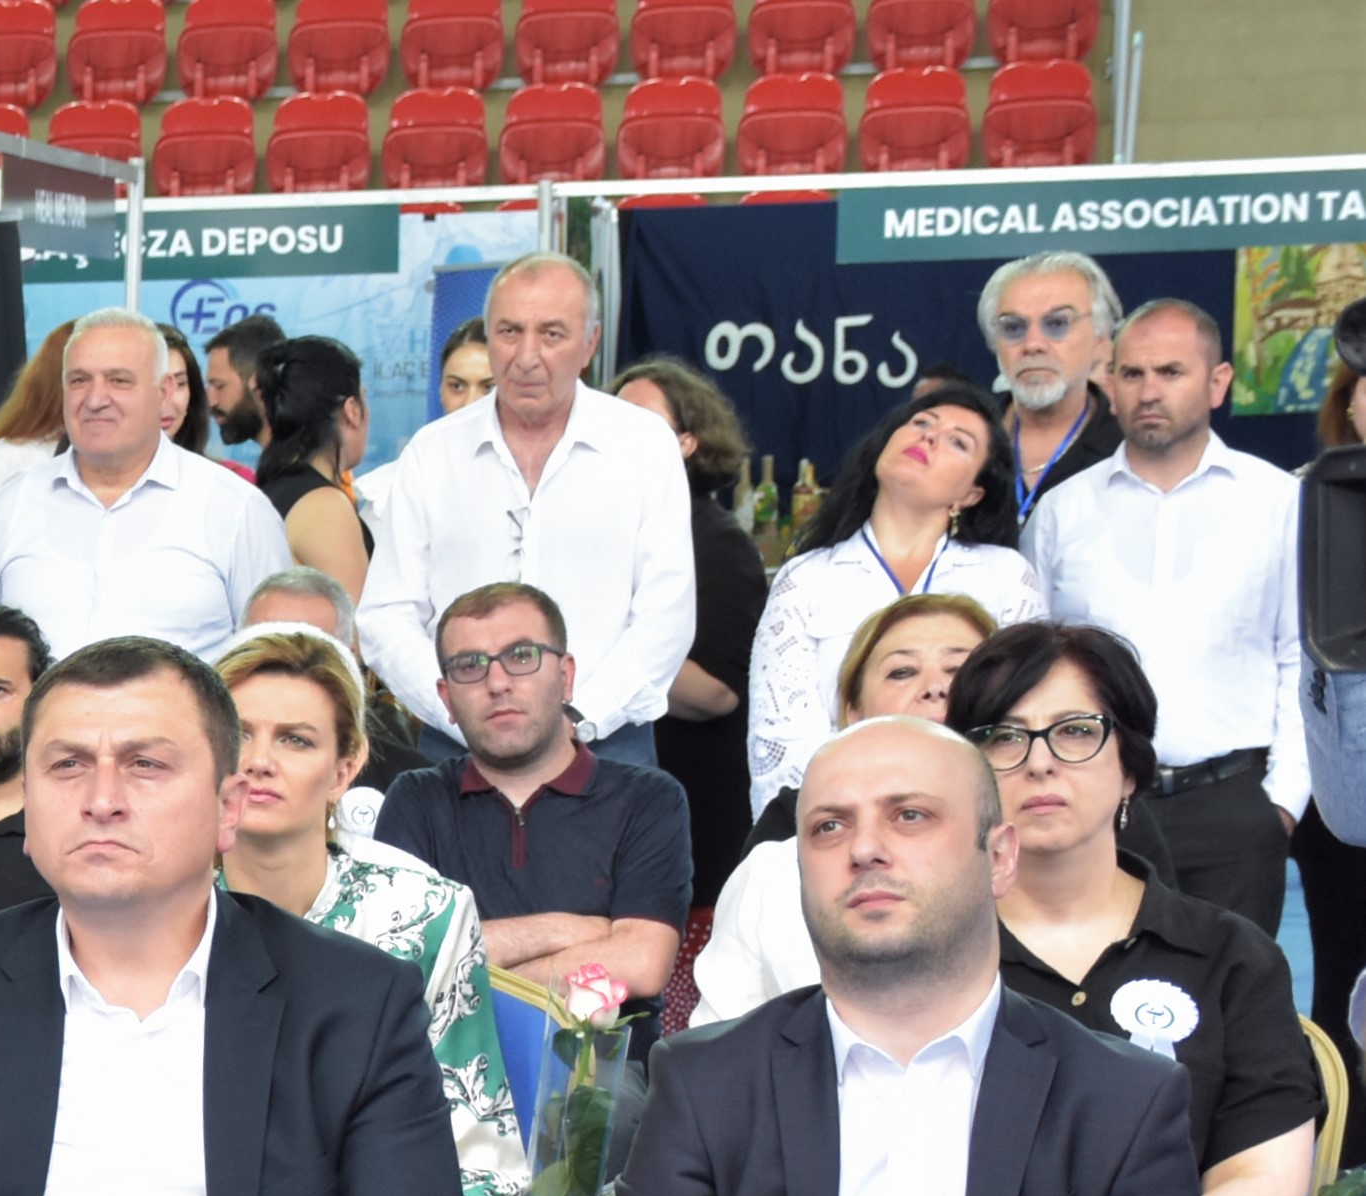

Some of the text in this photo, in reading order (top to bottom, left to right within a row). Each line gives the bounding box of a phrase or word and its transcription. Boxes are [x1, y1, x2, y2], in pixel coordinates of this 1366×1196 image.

[883, 203, 1044, 239] MEDICAL
[1050, 193, 1309, 233] ASSOCIATION
[201, 223, 344, 257] DEPOSU
[704, 314, 918, 388] თანა
